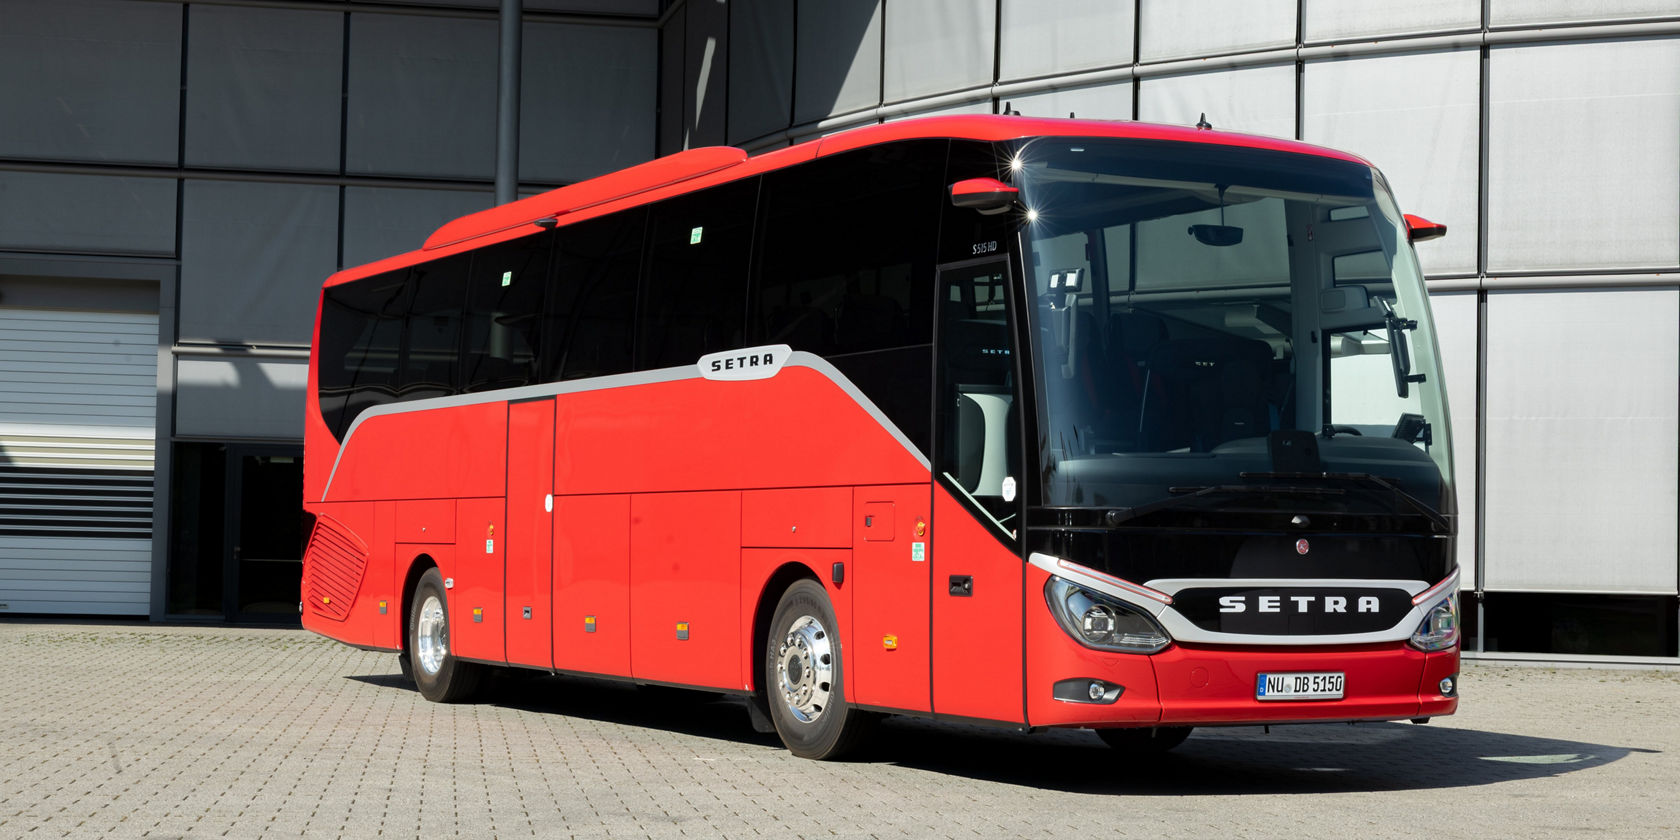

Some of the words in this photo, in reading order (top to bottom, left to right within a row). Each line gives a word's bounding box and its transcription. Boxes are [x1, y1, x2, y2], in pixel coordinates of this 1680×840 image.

[711, 353, 773, 372] SETRA
[1219, 596, 1380, 613] SETRA
[1267, 677, 1284, 693] NU
[1294, 676, 1310, 693] DB
[1312, 676, 1342, 692] 5150
